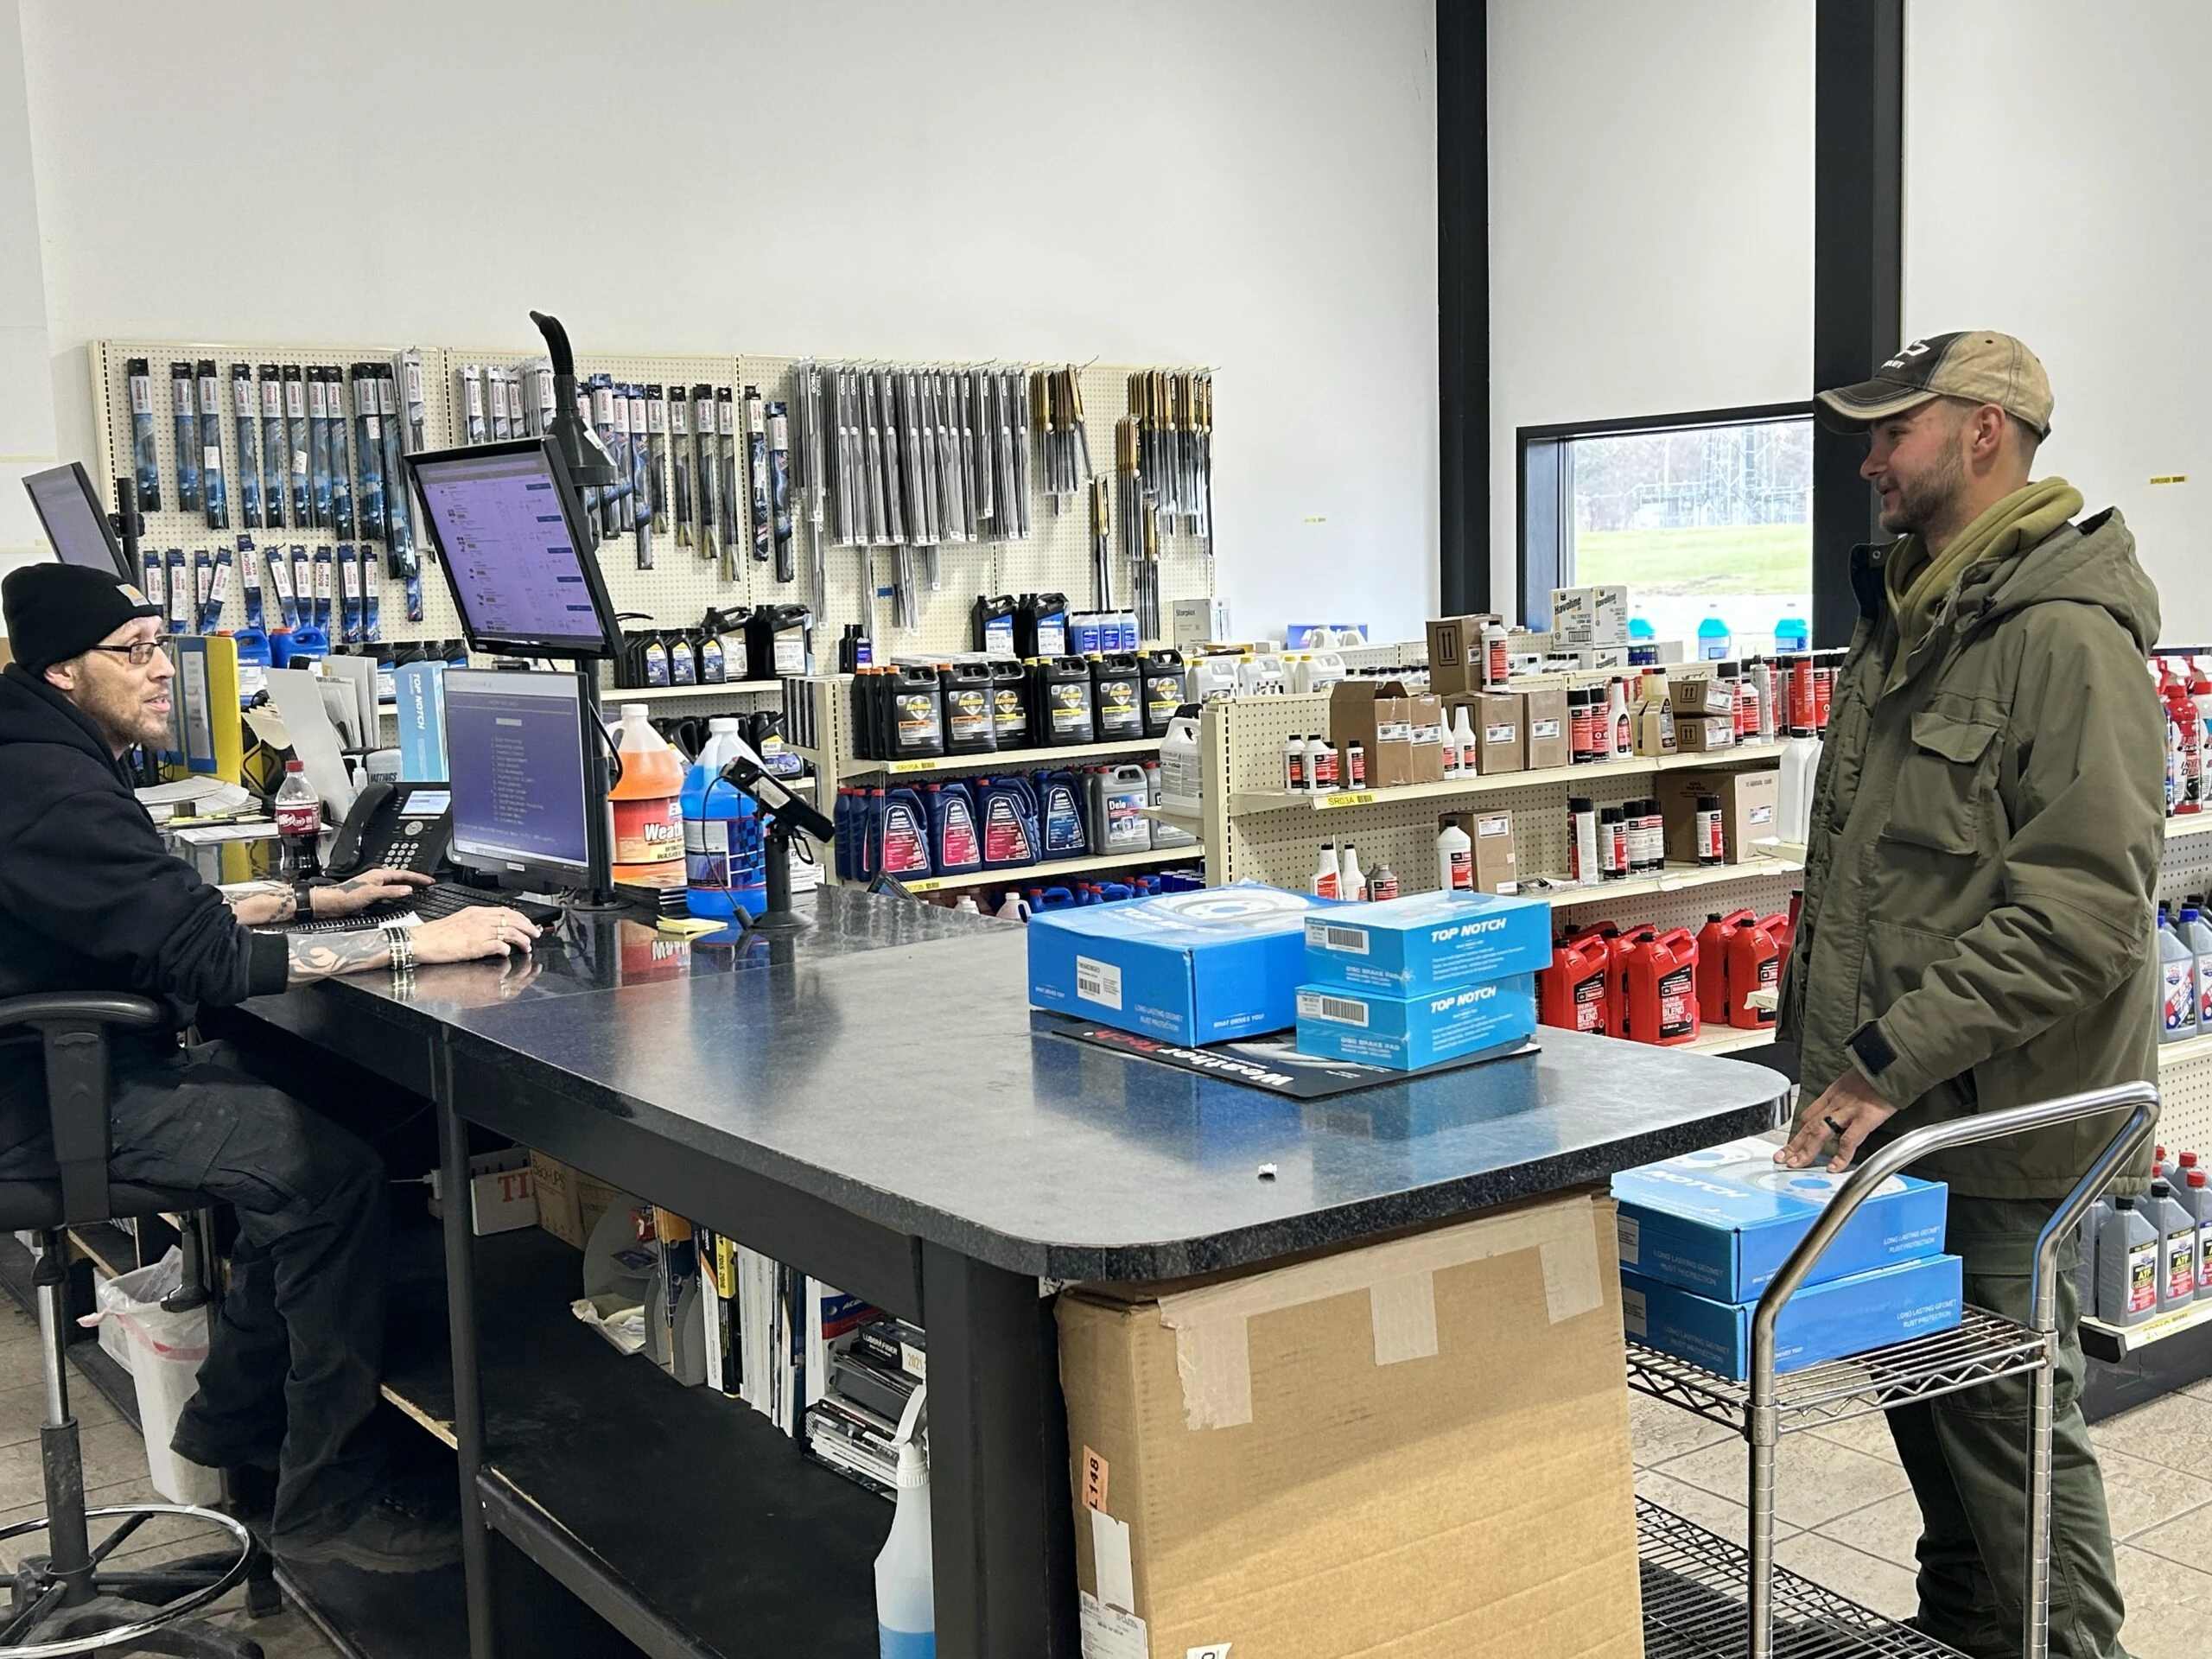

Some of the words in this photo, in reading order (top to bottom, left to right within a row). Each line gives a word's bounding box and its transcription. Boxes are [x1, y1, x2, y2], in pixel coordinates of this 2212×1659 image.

[1554, 597, 1581, 615] Havoline
[416, 696, 425, 730] NOTCH
[1109, 800, 1126, 810] Delo
[1328, 797, 1355, 805] SR03A
[1431, 928, 1458, 944] TOP
[1460, 917, 1508, 937] NOTCH
[1362, 968, 1383, 977] BRAKE
[1430, 998, 1455, 1014] TOP
[1458, 985, 1497, 1007] NOTCH
[1577, 1011, 1598, 1024] BLEND
[1662, 1007, 1684, 1020] BLEND
[1358, 1039, 1382, 1050] BRAKE
[1899, 1231, 1919, 1243] LASTING
[2176, 1255, 2189, 1267] ATF
[2138, 1270, 2152, 1281] ATF
[1897, 1312, 1911, 1320] LONG
[1912, 1304, 1934, 1317] LASTING
[1904, 1319, 1917, 1328] RUST
[1918, 1311, 1951, 1325] PROTECTION
[1090, 1457, 1099, 1510] L148
